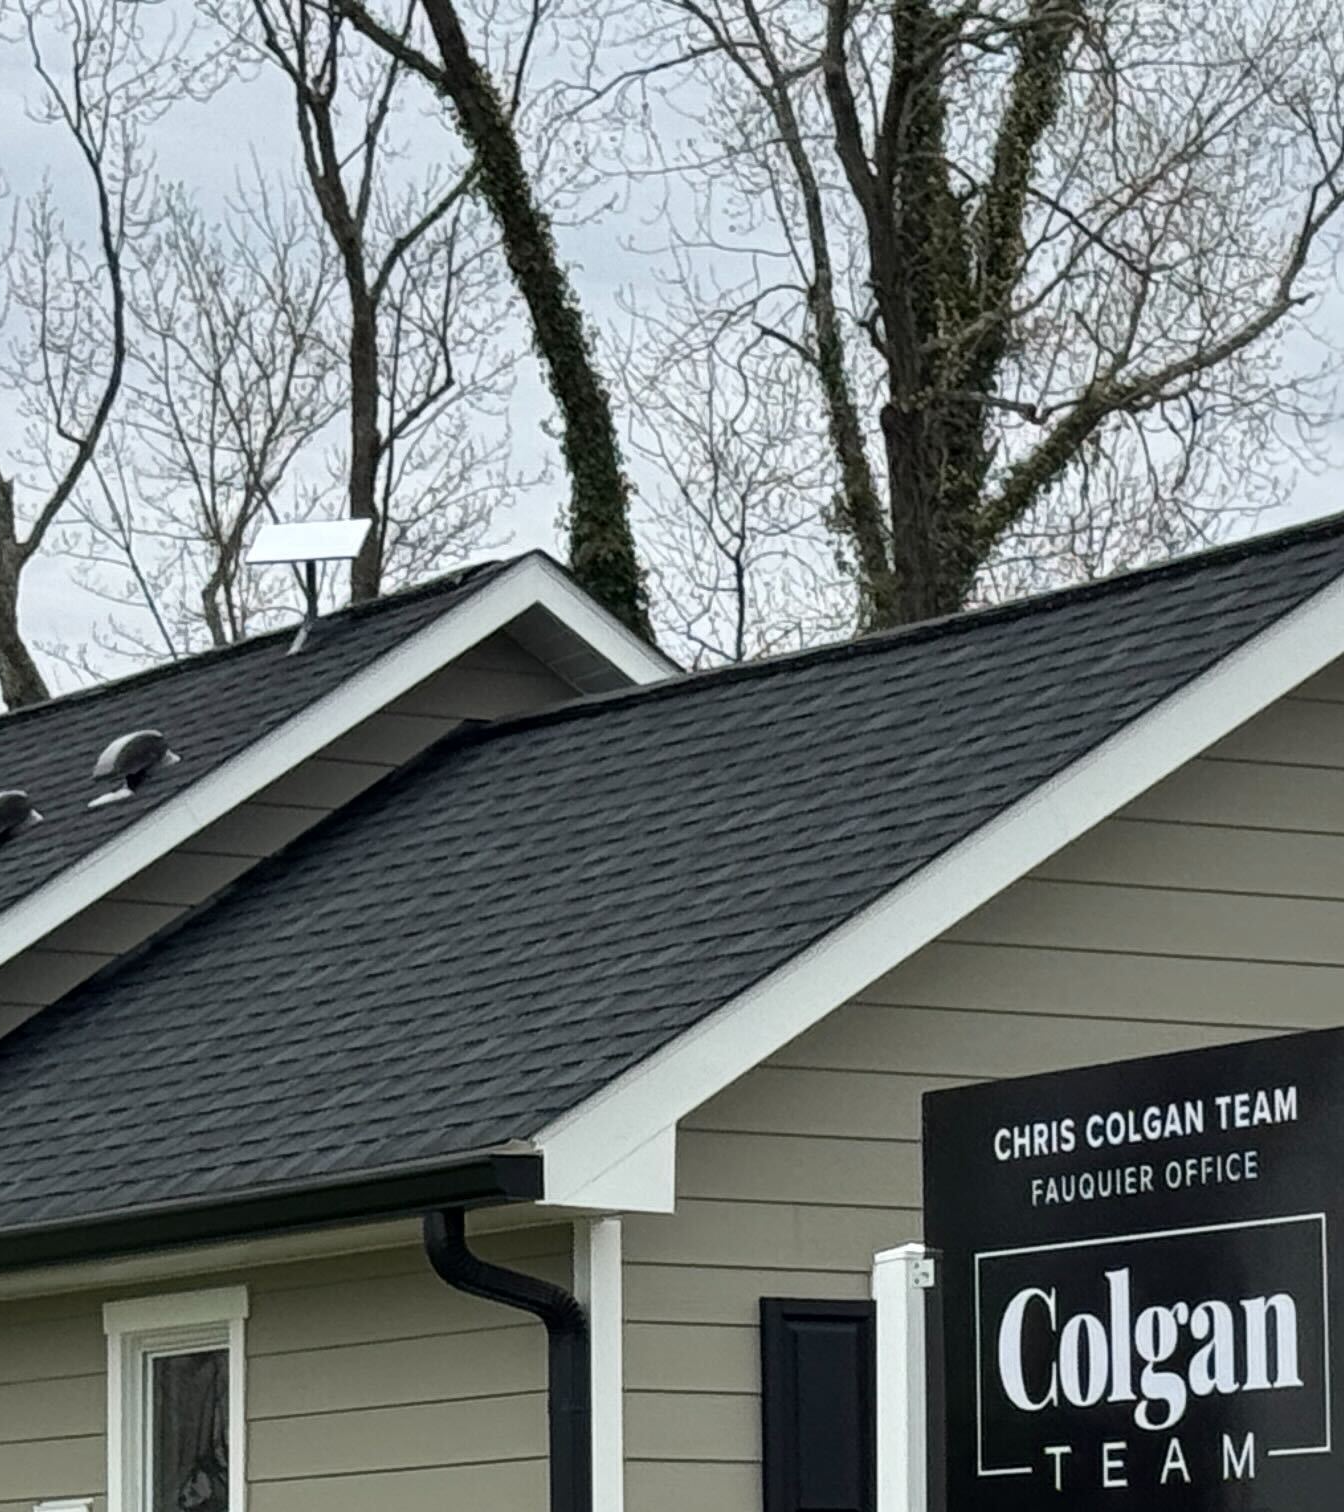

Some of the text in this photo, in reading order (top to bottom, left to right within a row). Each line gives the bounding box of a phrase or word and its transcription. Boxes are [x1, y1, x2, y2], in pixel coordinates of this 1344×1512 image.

[994, 1085, 1299, 1161] CHRIS COLGAN TEAM
[1030, 1151, 1259, 1207] FAUQUIER OFFICE
[997, 1266, 1305, 1431] Colgan
[1044, 1432, 1256, 1492] TEAM
